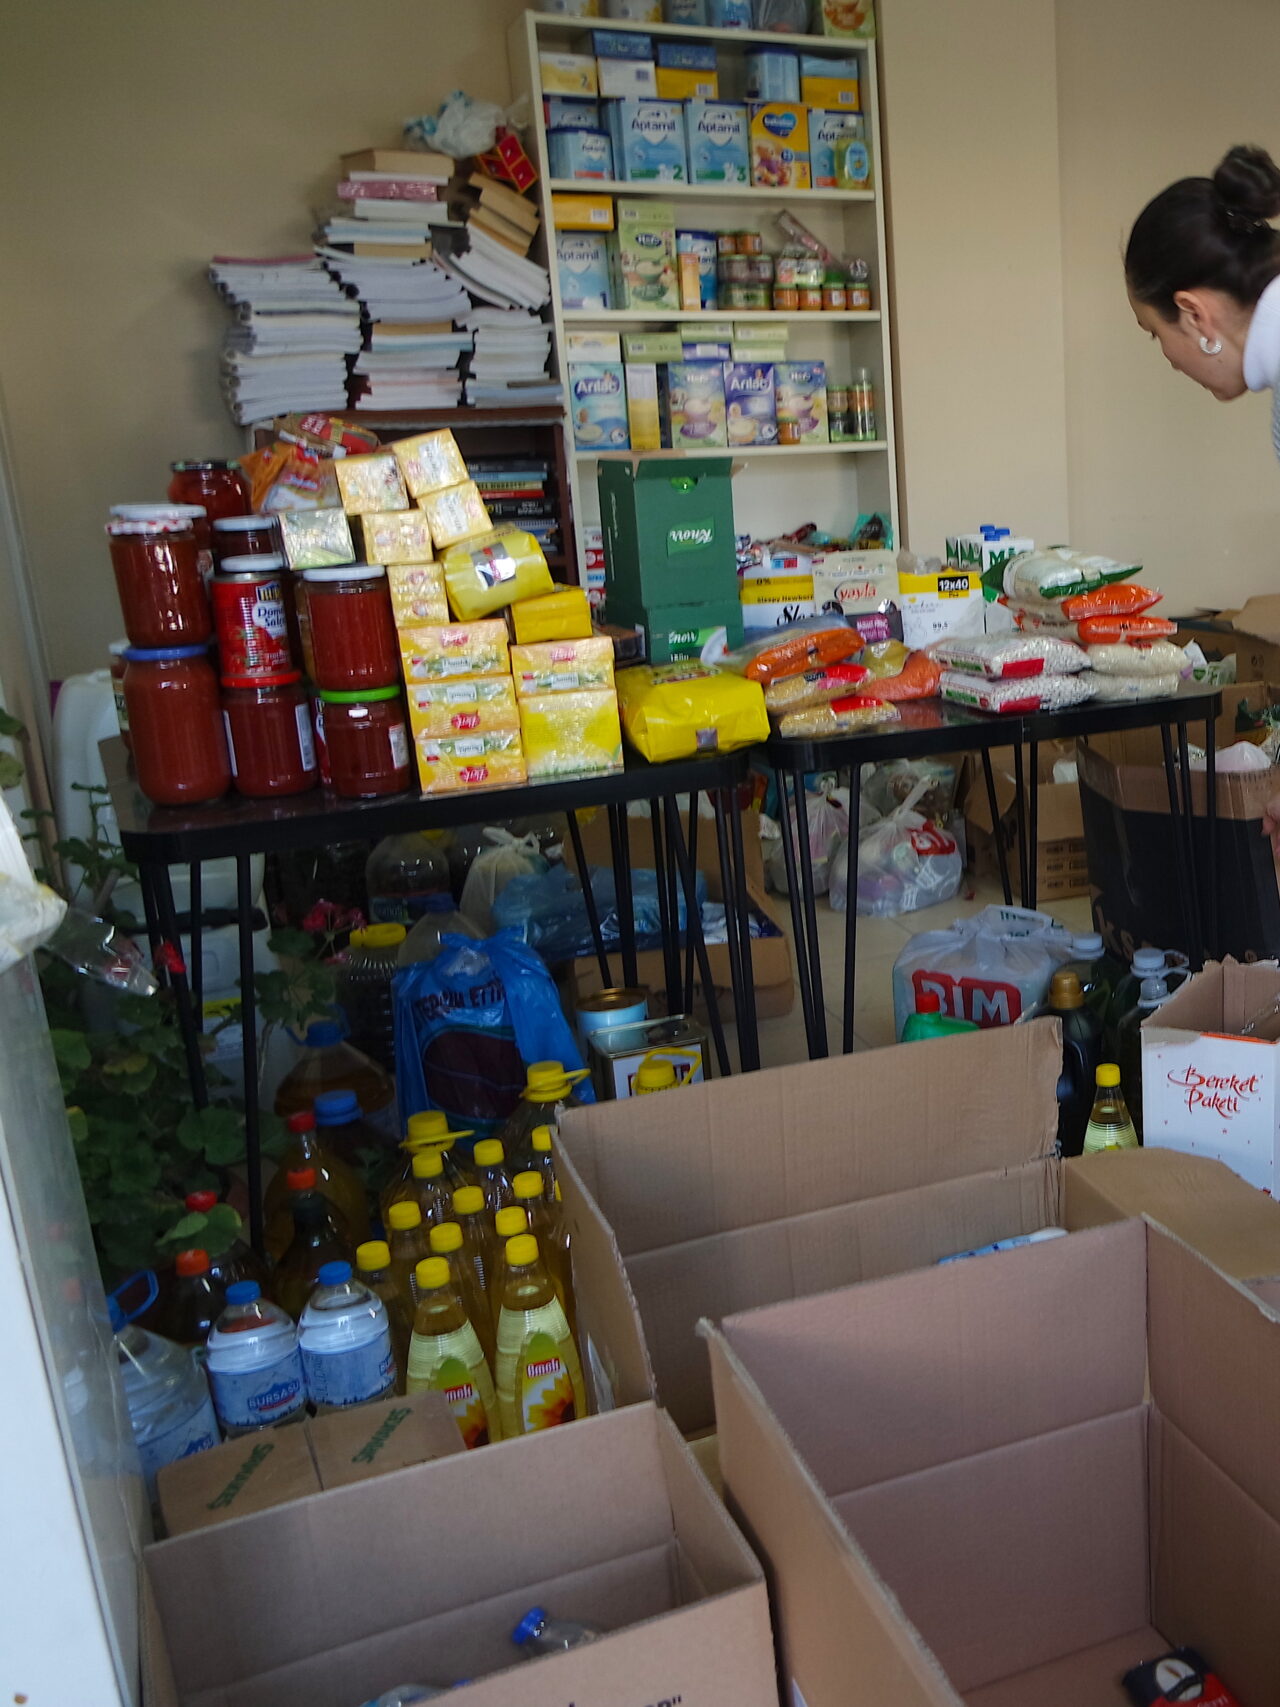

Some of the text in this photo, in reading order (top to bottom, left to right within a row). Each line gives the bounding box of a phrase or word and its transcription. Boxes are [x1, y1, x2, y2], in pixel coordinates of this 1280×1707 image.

[631, 119, 675, 132] Aptamil
[698, 121, 740, 134] Aptamil
[673, 165, 683, 180] 2
[737, 166, 746, 182] 3
[669, 528, 713, 545] Knorr
[1168, 1063, 1259, 1094] Bereket
[1184, 1087, 1240, 1119] Paketi
